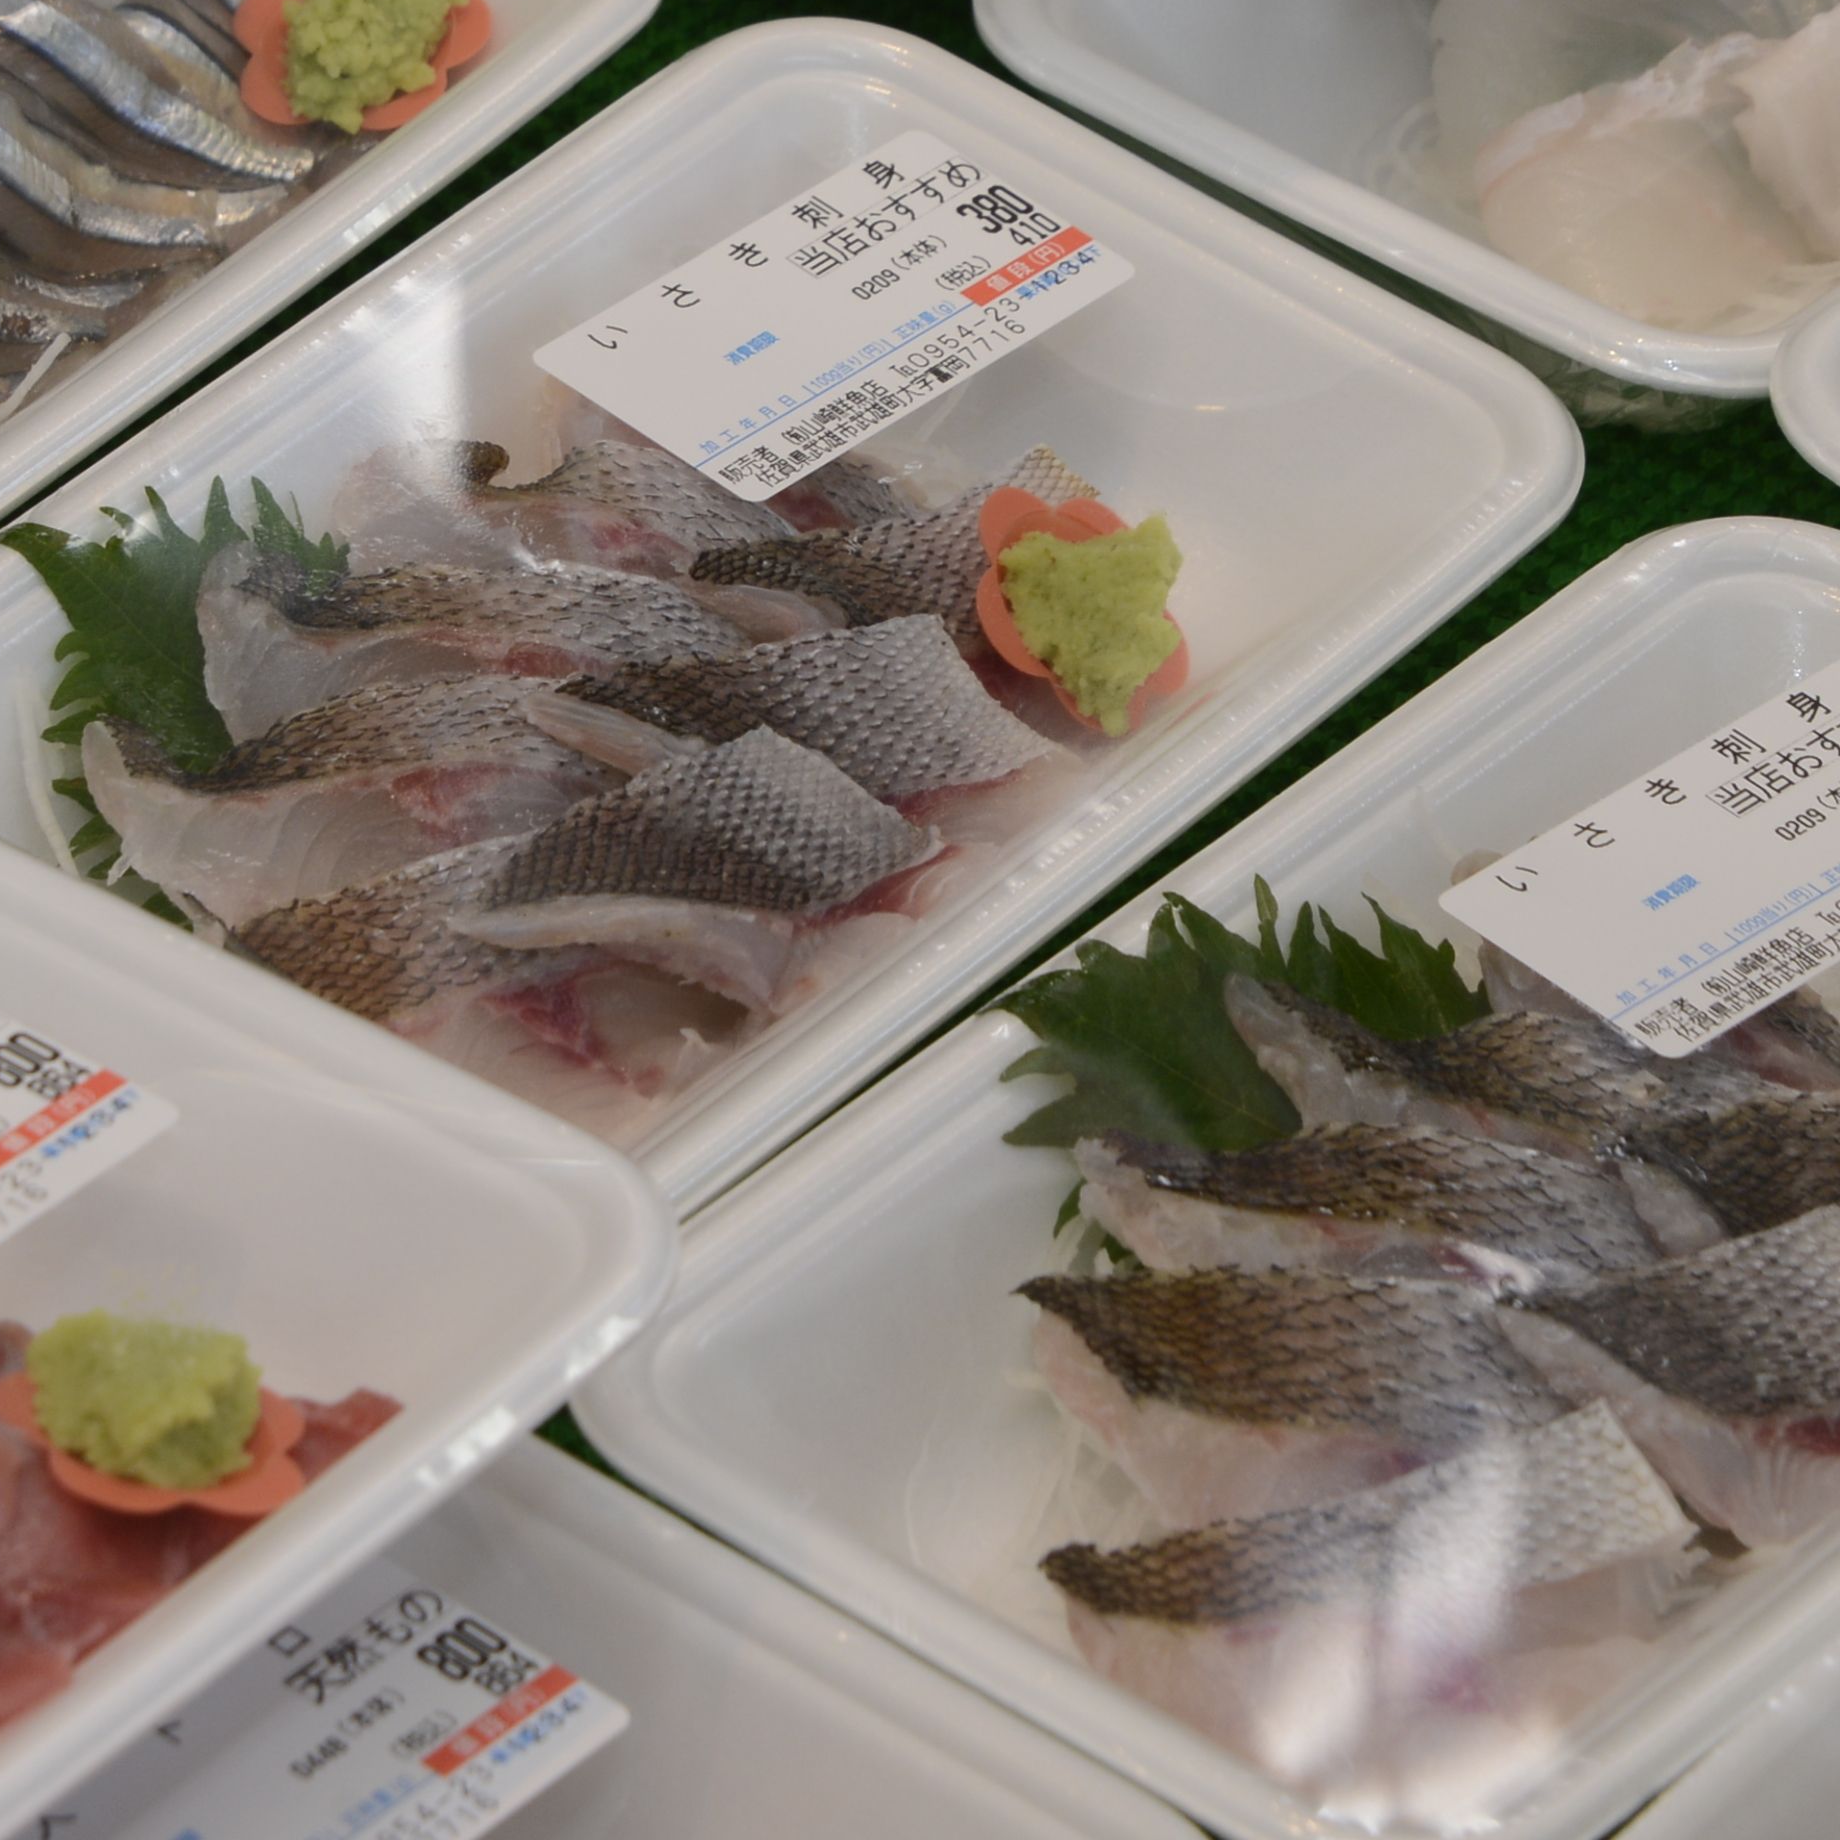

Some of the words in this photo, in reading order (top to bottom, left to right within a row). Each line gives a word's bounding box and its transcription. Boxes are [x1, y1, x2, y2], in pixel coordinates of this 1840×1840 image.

[795, 162, 981, 276] 当店おすすめ
[851, 235, 947, 301] 0209(本体)
[955, 184, 1034, 234] 380
[935, 255, 992, 291] (税込)
[1009, 212, 1062, 246] 410
[588, 160, 905, 350] いさき刺身
[982, 238, 1069, 293] 値段(円)
[697, 392, 798, 456] 加工年月日
[718, 445, 780, 484] 販売者
[1496, 691, 1832, 892] いさき刺身
[1613, 940, 1719, 1008] 加工年月日
[1634, 997, 1699, 1037] 販売者
[25, 1058, 92, 1100] 864
[284, 1589, 444, 1704] 天然もの
[417, 1617, 508, 1681] 800
[475, 1650, 540, 1697] 864
